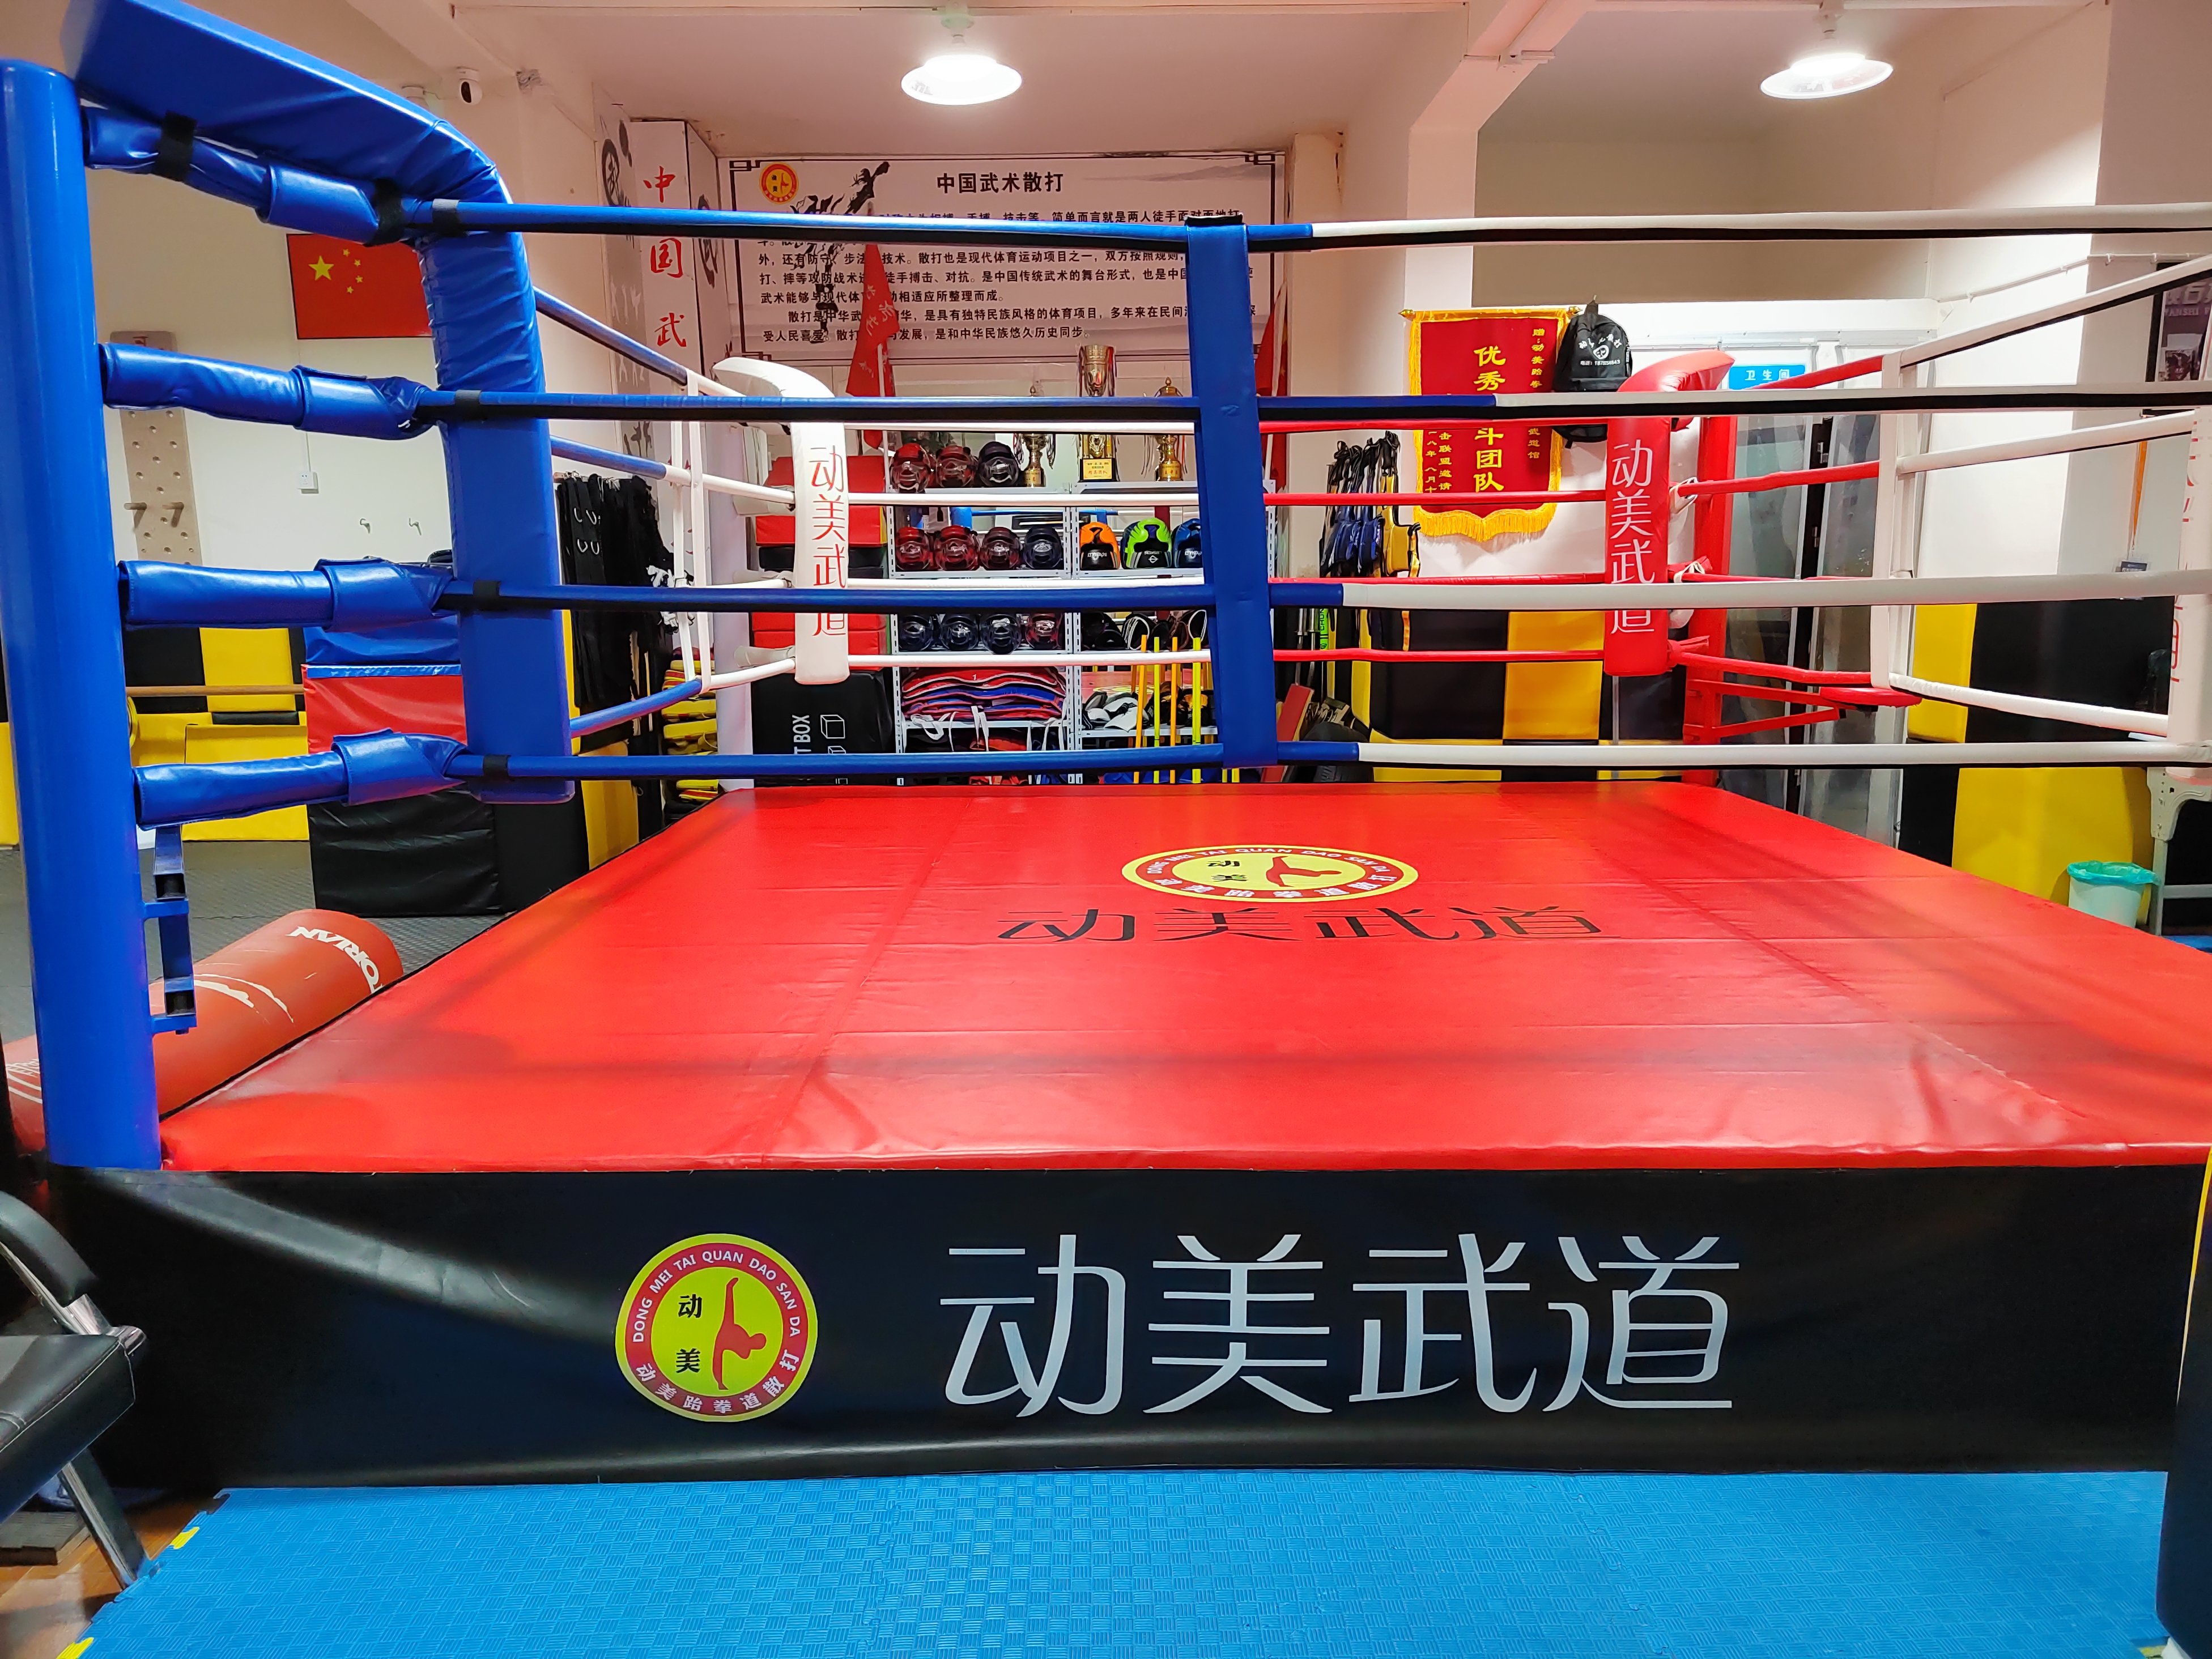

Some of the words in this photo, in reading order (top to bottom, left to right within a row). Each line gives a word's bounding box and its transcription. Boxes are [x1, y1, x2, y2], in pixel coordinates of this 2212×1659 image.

[937, 172, 1064, 193] 中国武术散打
[1745, 369, 1790, 381] 卫生间
[1473, 346, 1507, 492] 优秀斗团队
[792, 714, 811, 743] BOX
[1344, 857, 1379, 865] SAN
[997, 907, 1621, 942] 动美武道
[632, 1296, 653, 1343] DONG
[649, 1269, 674, 1294] MEI
[673, 1254, 696, 1271] TAI
[702, 1250, 744, 1264] QUAN
[748, 1257, 777, 1282] DAO
[776, 1282, 797, 1310] SAN
[789, 1316, 801, 1337] DA
[940, 1233, 1739, 1417] 动美武道
[636, 1350, 800, 1414] 动美跆拳道散打
